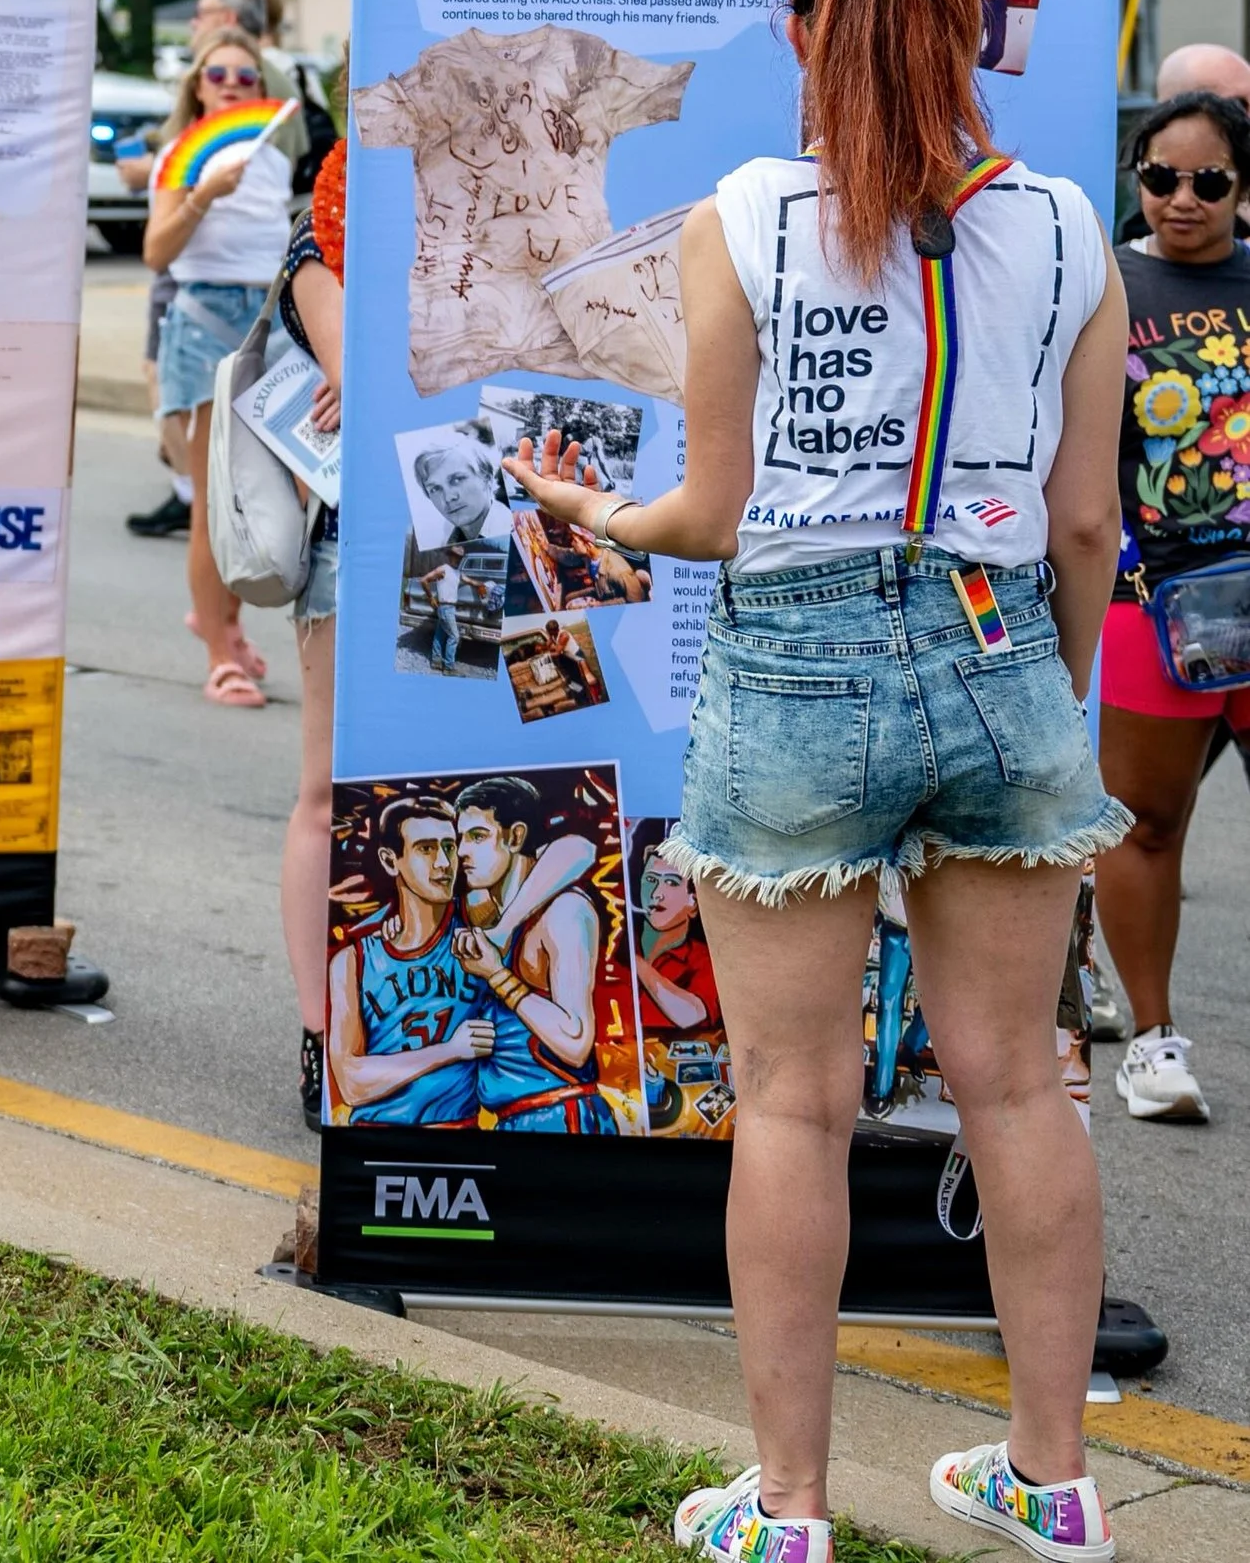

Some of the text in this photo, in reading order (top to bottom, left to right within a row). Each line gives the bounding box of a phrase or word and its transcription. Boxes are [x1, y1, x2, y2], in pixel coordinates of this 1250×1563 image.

[442, 8, 719, 25] continues to be shared through his many friends.
[793, 300, 889, 338] love
[1170, 309, 1233, 337] FOR
[788, 344, 873, 381] has
[253, 360, 310, 419] LEXINGTON
[788, 384, 845, 414] no
[787, 414, 906, 455] labels
[747, 505, 813, 529] BANK
[674, 566, 716, 579] Bill was
[673, 585, 707, 596] would
[672, 602, 702, 613] art in
[672, 619, 706, 630] exhibi
[672, 636, 702, 647] oasis
[671, 653, 699, 664] from
[670, 669, 701, 684] refug
[670, 686, 697, 698] Bill's
[364, 965, 479, 1021] LIONS
[374, 1175, 490, 1221] FMA
